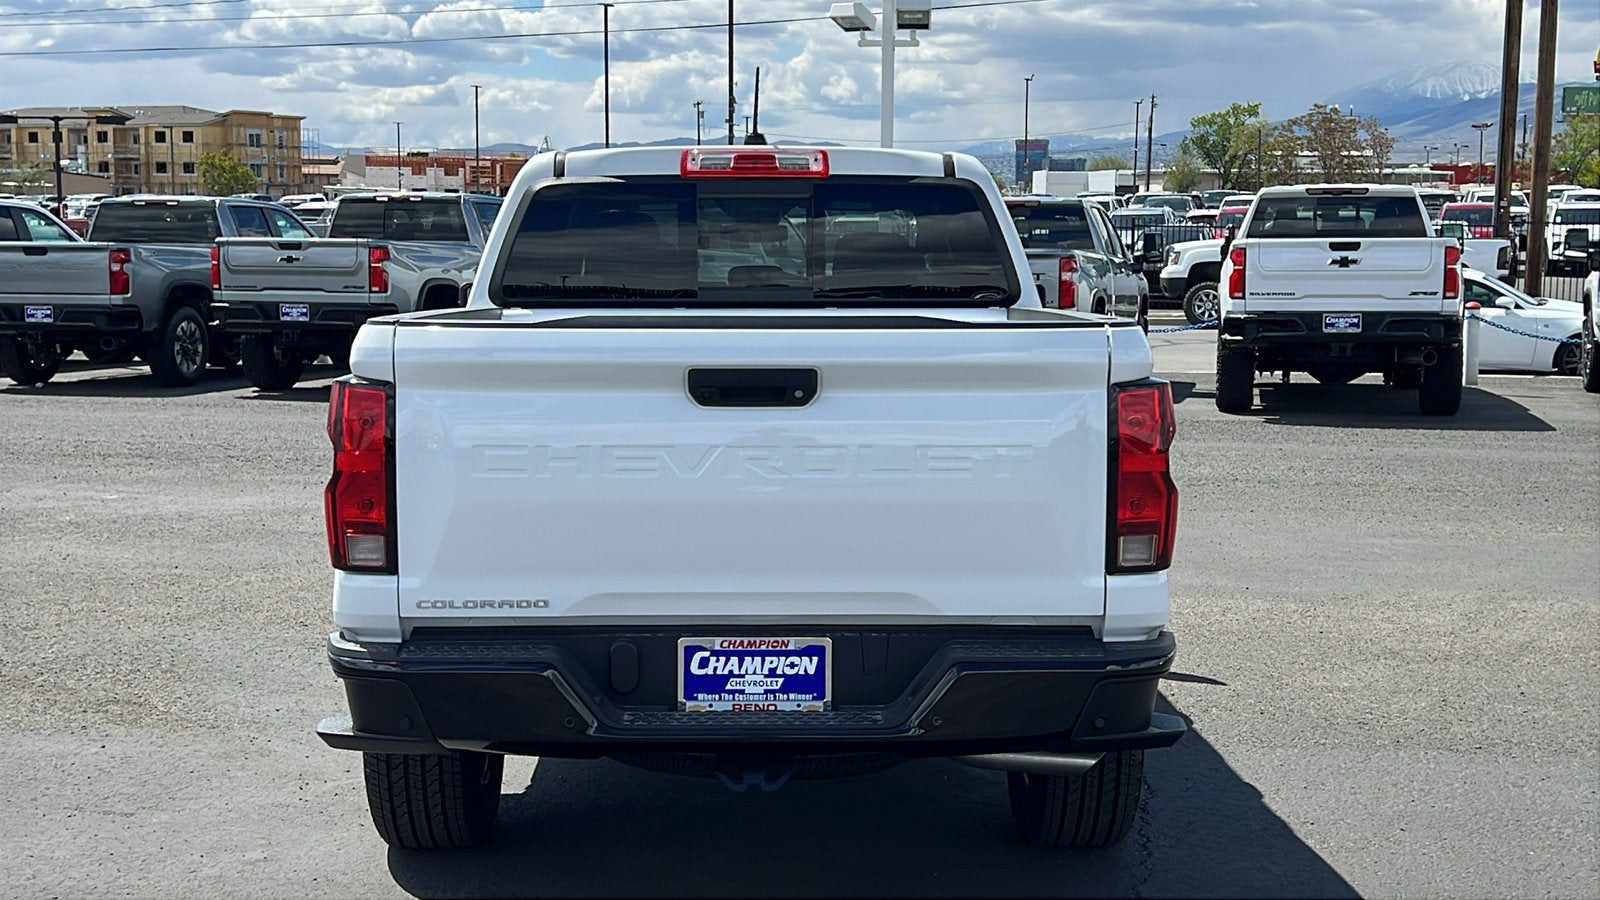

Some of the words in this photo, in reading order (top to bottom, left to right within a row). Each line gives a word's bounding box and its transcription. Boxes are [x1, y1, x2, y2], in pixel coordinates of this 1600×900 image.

[471, 444, 1032, 478] CHEVROLET
[415, 599, 549, 609] COLORADO
[719, 639, 791, 649] CHAMPION
[690, 651, 818, 675] CHAMPION
[729, 680, 780, 688] CHEVROLET
[721, 693, 733, 701] The
[734, 693, 766, 701] Customer
[775, 693, 788, 701] The
[732, 703, 778, 711] RENO
